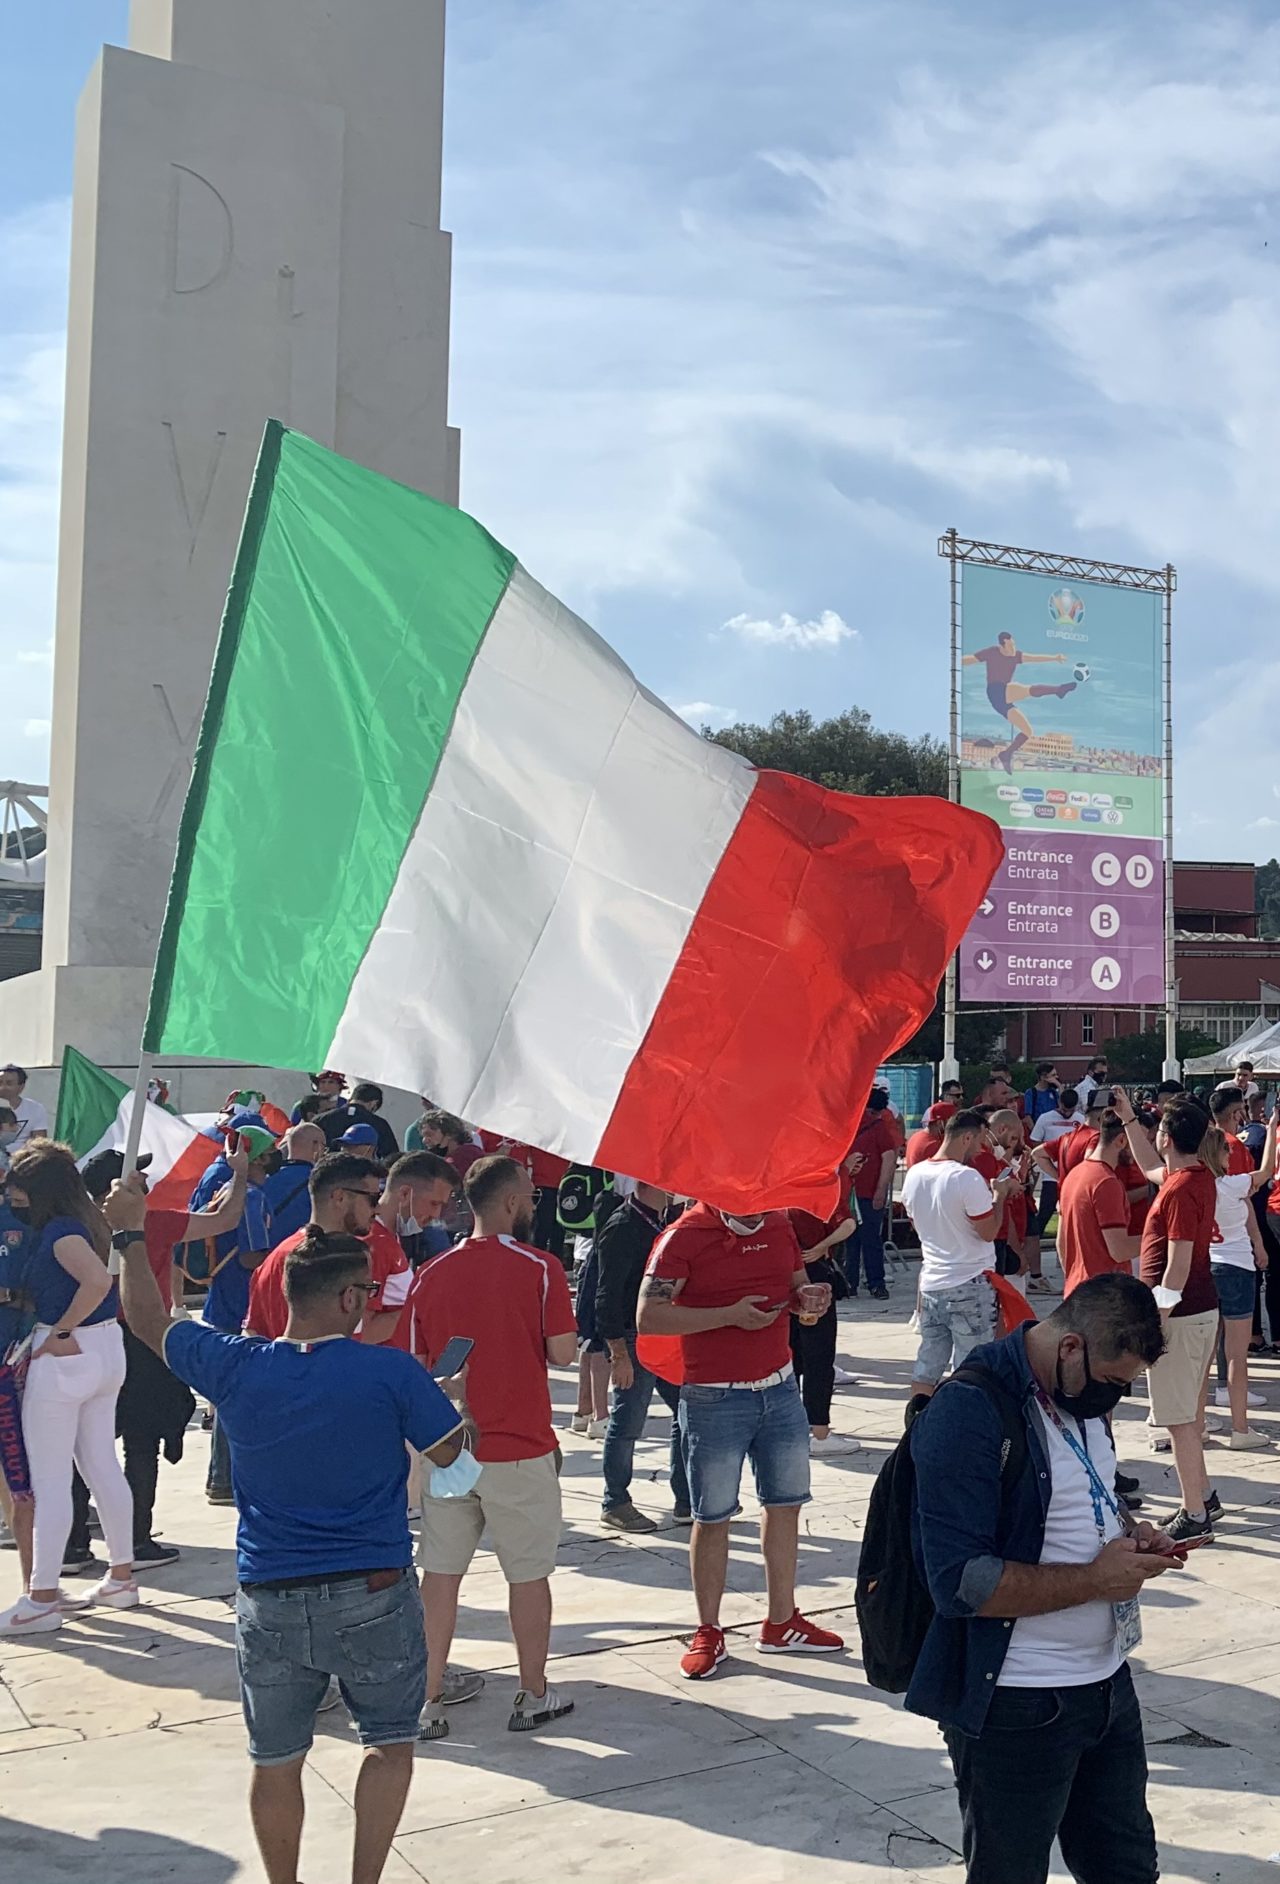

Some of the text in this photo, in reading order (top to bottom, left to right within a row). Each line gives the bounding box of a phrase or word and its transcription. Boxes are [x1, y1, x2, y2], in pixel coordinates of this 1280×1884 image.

[1008, 848, 1073, 864] Entrance
[1008, 865, 1059, 880] Entrata
[1099, 860, 1147, 881] C D
[1007, 901, 1073, 917] Entrance
[1007, 919, 1058, 933] Entrata
[1098, 911, 1112, 930] B
[1007, 955, 1073, 969] Entrance
[1007, 973, 1058, 986] Entrata
[1098, 964, 1113, 982] A
